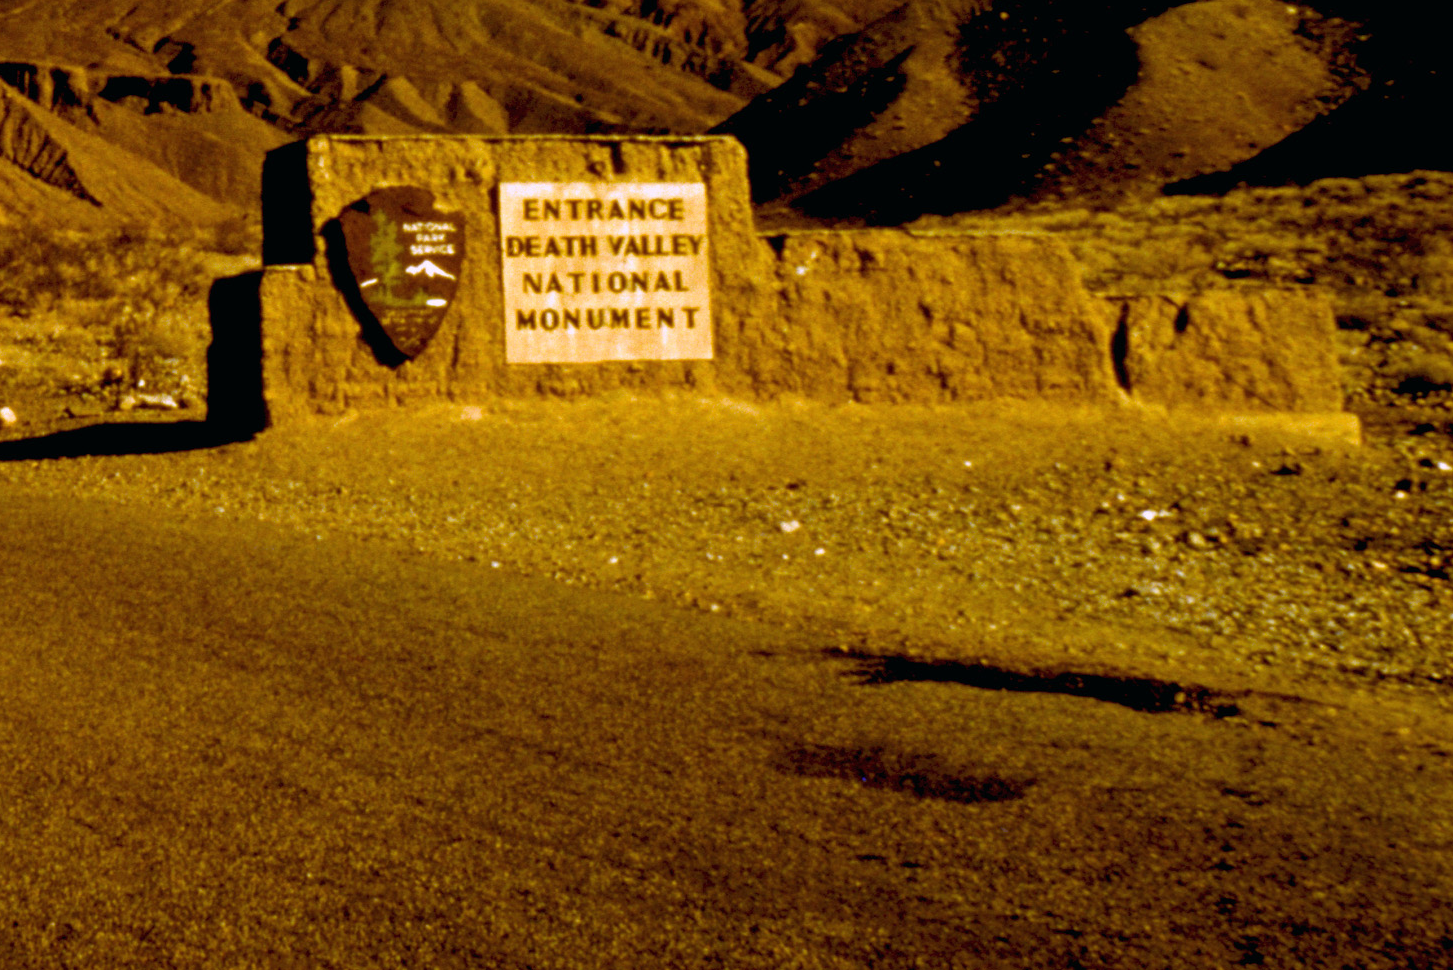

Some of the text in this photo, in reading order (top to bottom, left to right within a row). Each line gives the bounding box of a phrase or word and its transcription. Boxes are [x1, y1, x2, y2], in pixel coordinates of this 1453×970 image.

[523, 198, 684, 221] ENTRANCE
[416, 233, 445, 242] PARK
[506, 235, 703, 257] DEATH VALLEY
[410, 244, 455, 255] SERVICE
[522, 271, 689, 294] NATIONAL
[515, 307, 700, 331] MONUMENT
